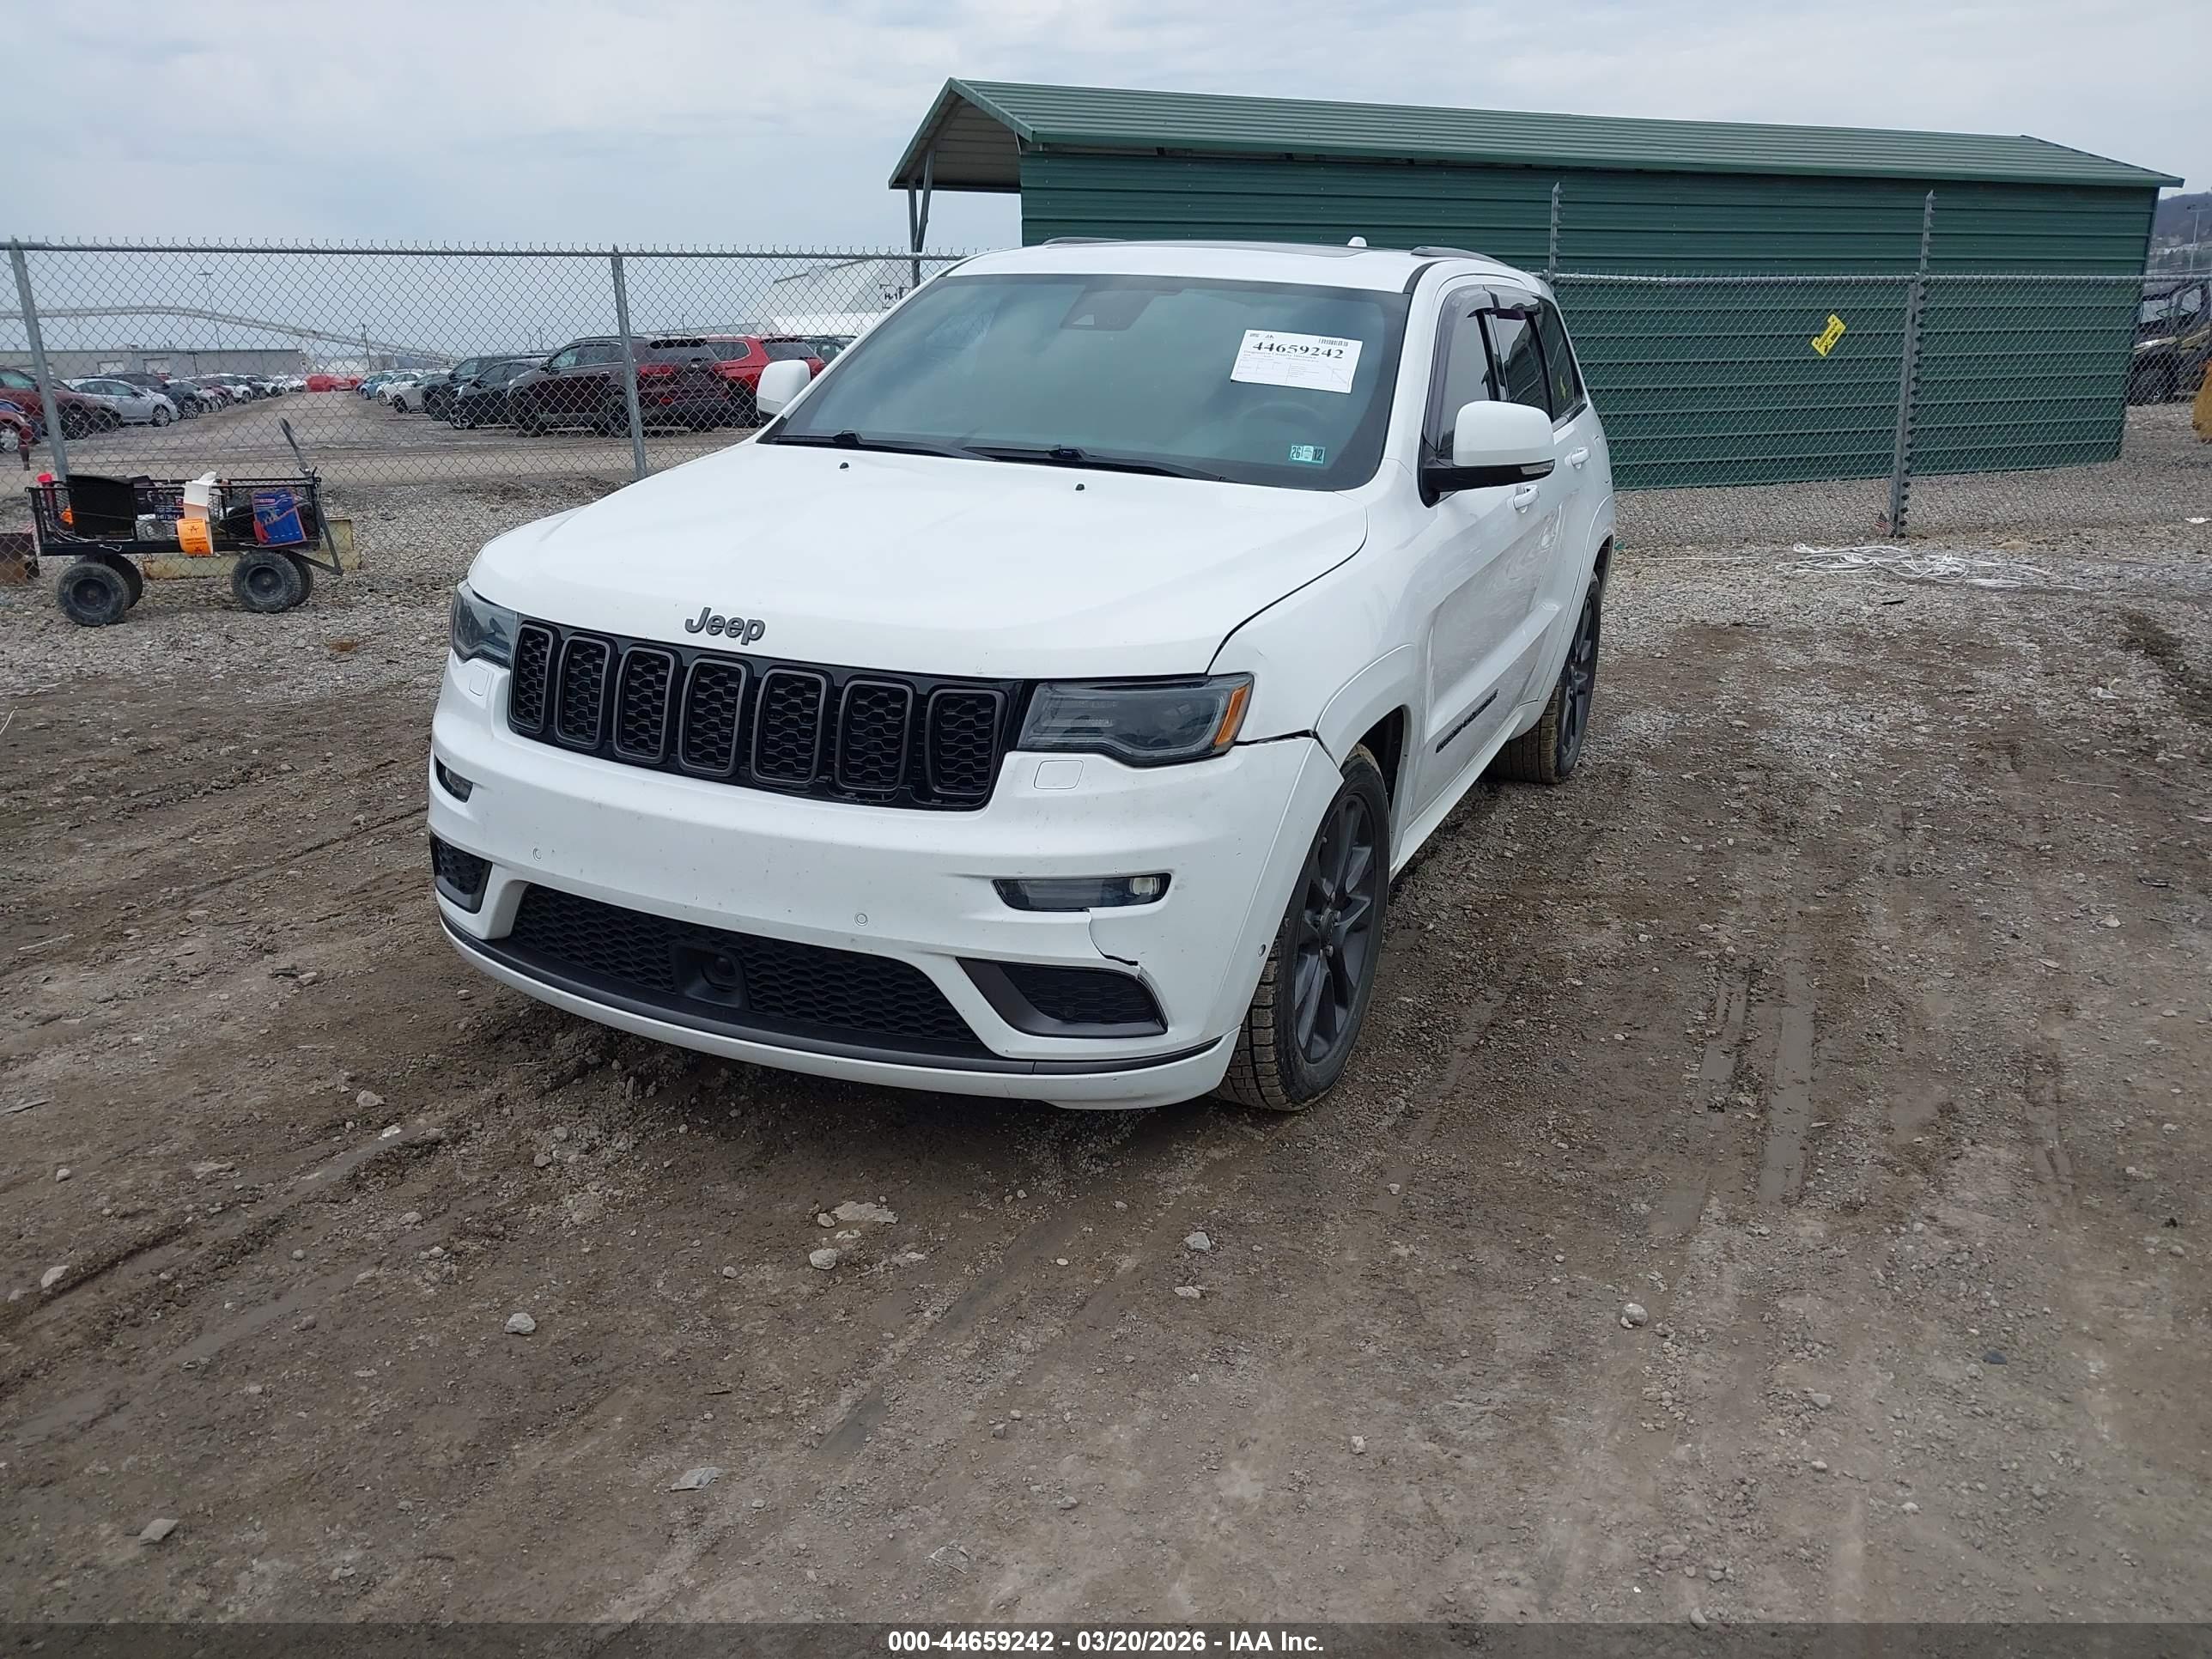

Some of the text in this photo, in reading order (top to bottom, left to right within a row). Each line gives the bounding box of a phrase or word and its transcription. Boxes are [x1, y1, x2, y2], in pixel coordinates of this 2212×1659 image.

[1252, 341, 1345, 360] 44659242
[1291, 446, 1323, 461] 26 12
[684, 606, 766, 647] Jeep
